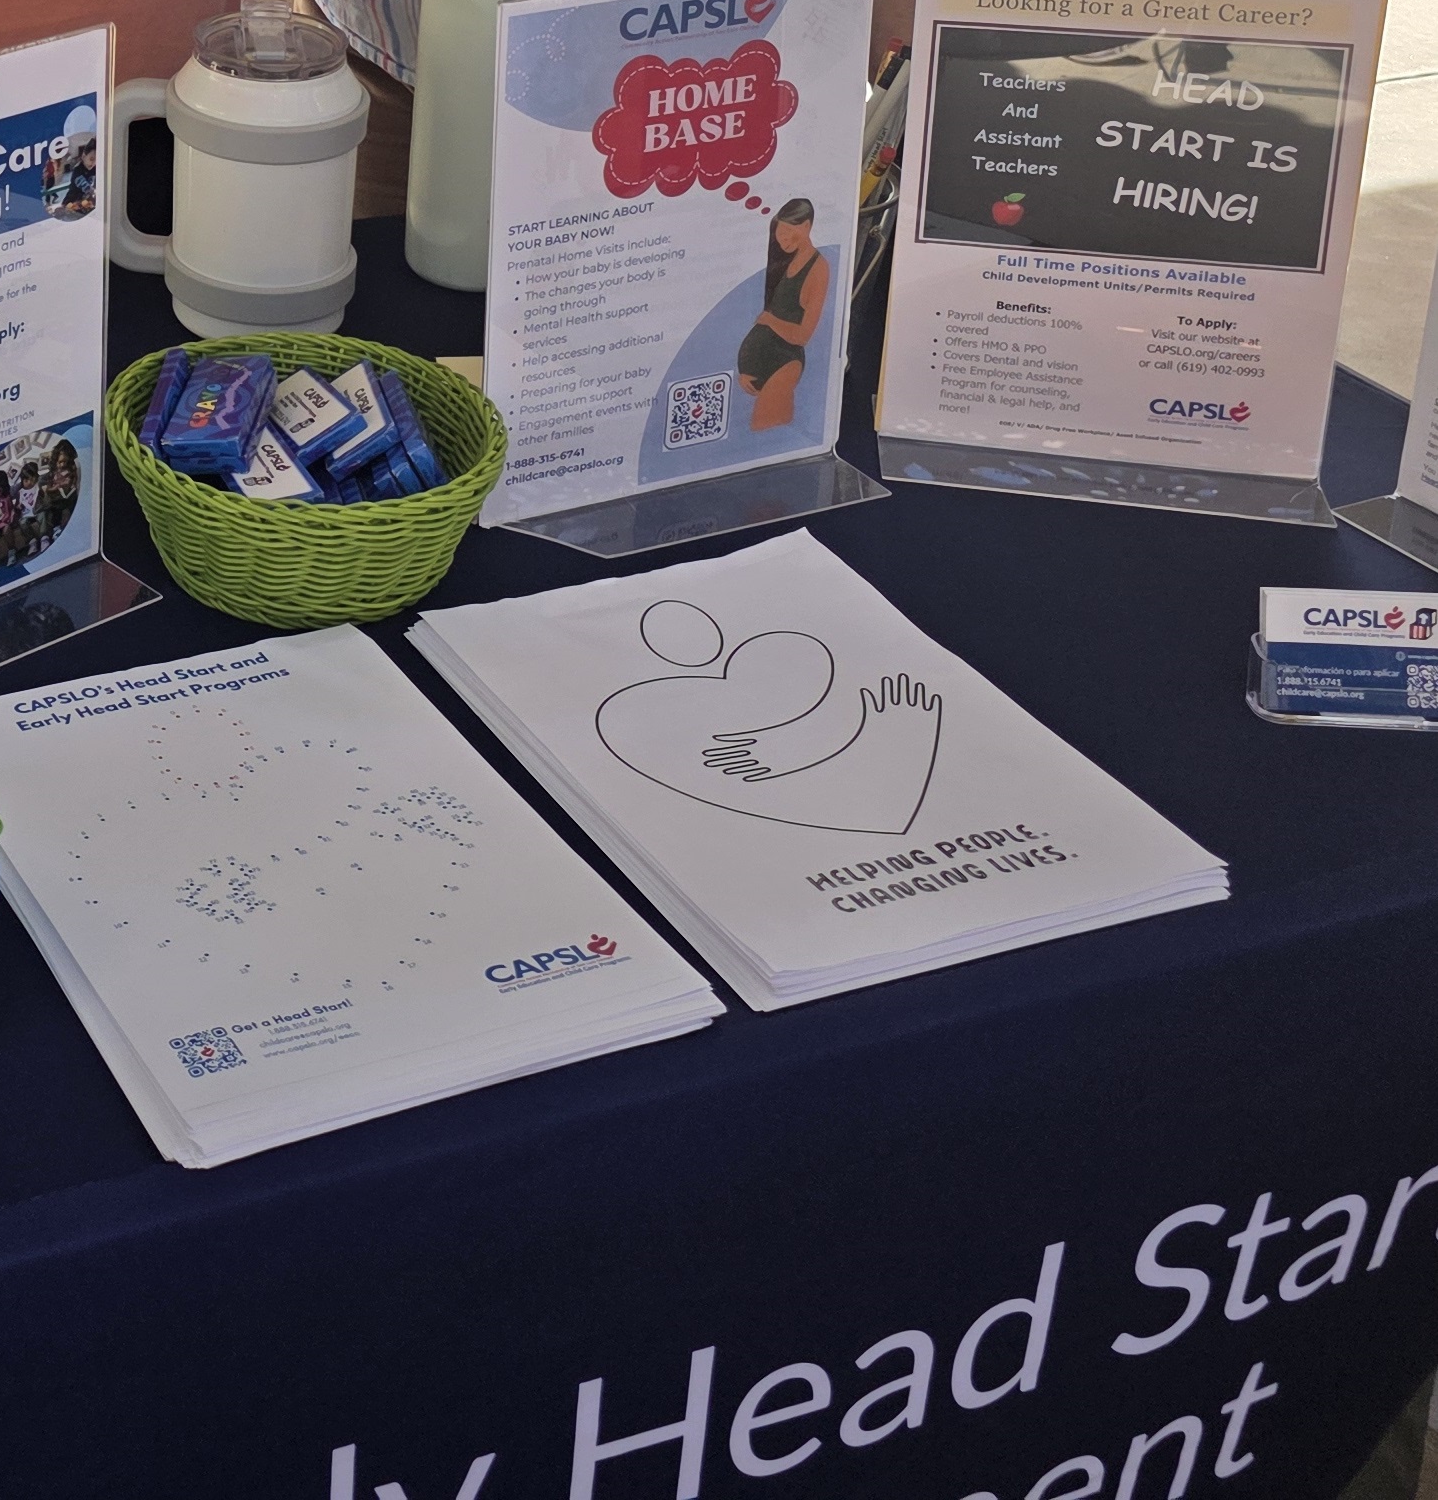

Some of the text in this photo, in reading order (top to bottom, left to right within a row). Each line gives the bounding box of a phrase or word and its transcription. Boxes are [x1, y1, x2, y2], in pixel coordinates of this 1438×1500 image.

[1121, 3, 1133, 16] a
[1142, 0, 1209, 20] Great
[1218, 3, 1312, 25] Career?
[648, 75, 757, 118] HOME
[979, 72, 1066, 92] Teachers
[1151, 70, 1264, 111] HEAD
[1002, 103, 1038, 119] And
[644, 111, 746, 153] BASE
[974, 129, 1062, 149] Assistant
[1096, 121, 1298, 172] START IS
[972, 156, 1058, 177] Teachers
[1113, 177, 1258, 224] HIRING!
[508, 203, 652, 236] START LEARNING ABOUT
[0, 233, 24, 251] and
[507, 225, 614, 252] YOUR BABY NOW!
[507, 235, 671, 271] Prenatal Home Visits include:
[525, 248, 685, 284] How your baby is developing
[997, 254, 1246, 285] Full Time Positions Available
[524, 268, 666, 301] The changes your body is
[982, 270, 1255, 301] Child Development Units/Permits Required
[523, 295, 606, 320] going through
[523, 303, 648, 333] Mental Health support
[947, 309, 1082, 330] Payroll deductions 100%
[996, 300, 1051, 314] Benefits:
[945, 324, 989, 335] covered
[1151, 328, 1260, 346] Visit our website at
[1176, 315, 1236, 330] To Apply:
[522, 335, 567, 350] services
[522, 332, 663, 366] Help accessing additional
[1146, 343, 1260, 362] CAPSLO.org/careers
[520, 367, 652, 398] Preparing for your baby
[521, 366, 576, 382] resources
[1138, 359, 1265, 377] or call (619) 402-0993
[505, 456, 623, 485] childcare@capslo.org
[506, 447, 584, 470] 1-888-315-6741
[14, 651, 269, 713] CAPSLO's Head Start and
[15, 668, 289, 731] Early Head Start Programs
[806, 824, 1049, 892] HELPING PEOPLE.
[831, 845, 1079, 913] CHANGING LIVES.
[231, 1021, 257, 1033] Get
[271, 1008, 311, 1024] Head
[312, 998, 352, 1014] Start!
[568, 1166, 1438, 1500] Head Star
